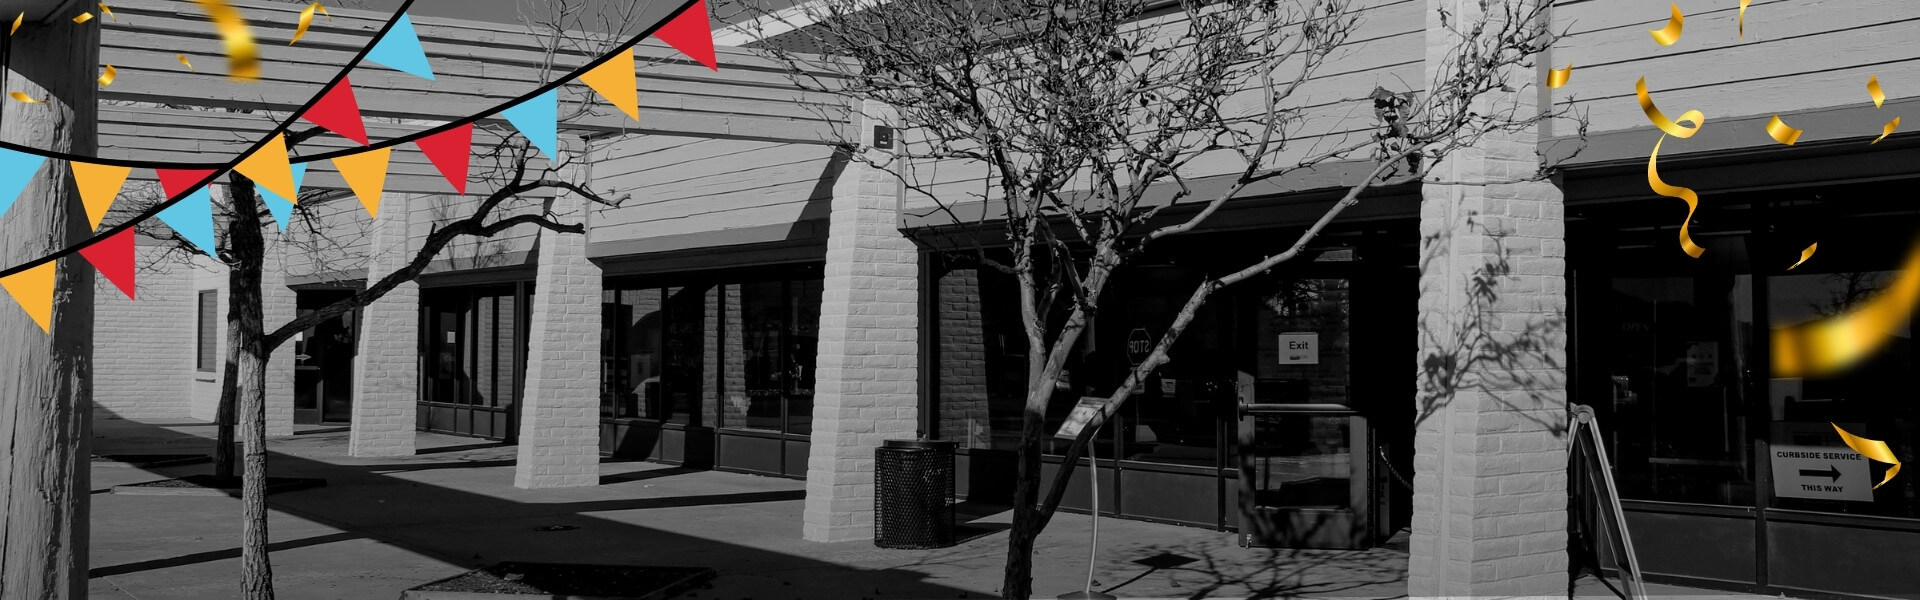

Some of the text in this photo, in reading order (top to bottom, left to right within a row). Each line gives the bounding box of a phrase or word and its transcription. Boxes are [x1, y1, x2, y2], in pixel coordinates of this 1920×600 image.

[1289, 341, 1309, 350] Exit
[1776, 451, 1862, 461] CURBSIDE SERVICE
[1801, 484, 1843, 493] THIS WAY
